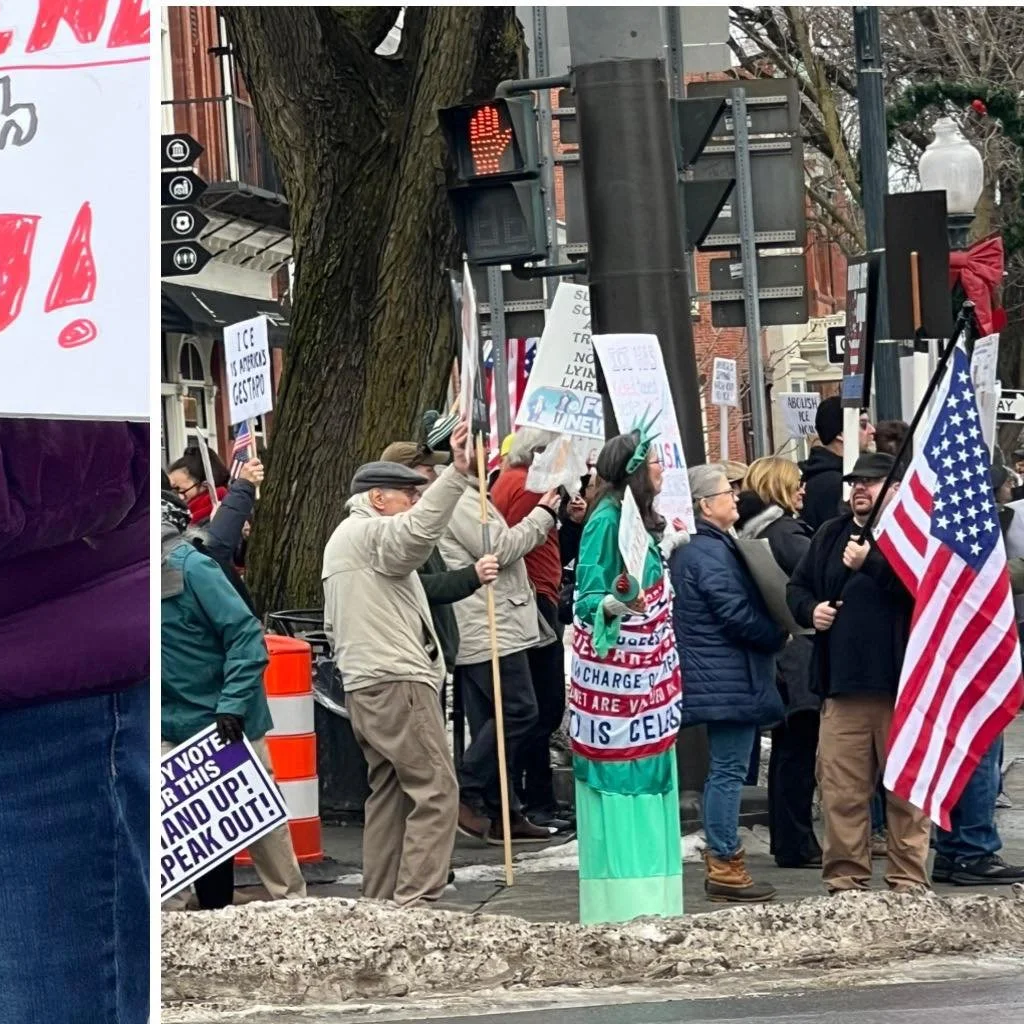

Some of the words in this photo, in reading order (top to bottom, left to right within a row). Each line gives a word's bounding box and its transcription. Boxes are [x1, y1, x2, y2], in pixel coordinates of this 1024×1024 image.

[237, 327, 254, 352] ICE
[572, 332, 592, 344] TR
[233, 374, 265, 406] GESTAPO
[561, 377, 597, 392] LIAR
[787, 397, 817, 409] ABOLISH
[997, 400, 1014, 411] AY
[798, 411, 810, 422] ICE
[583, 667, 641, 689] CHARGE
[591, 695, 621, 713] ARE
[591, 719, 612, 745] IS
[174, 731, 231, 773] VOTE
[179, 760, 221, 797] THIS
[208, 770, 254, 813] UP!
[218, 792, 276, 842] OUT!
